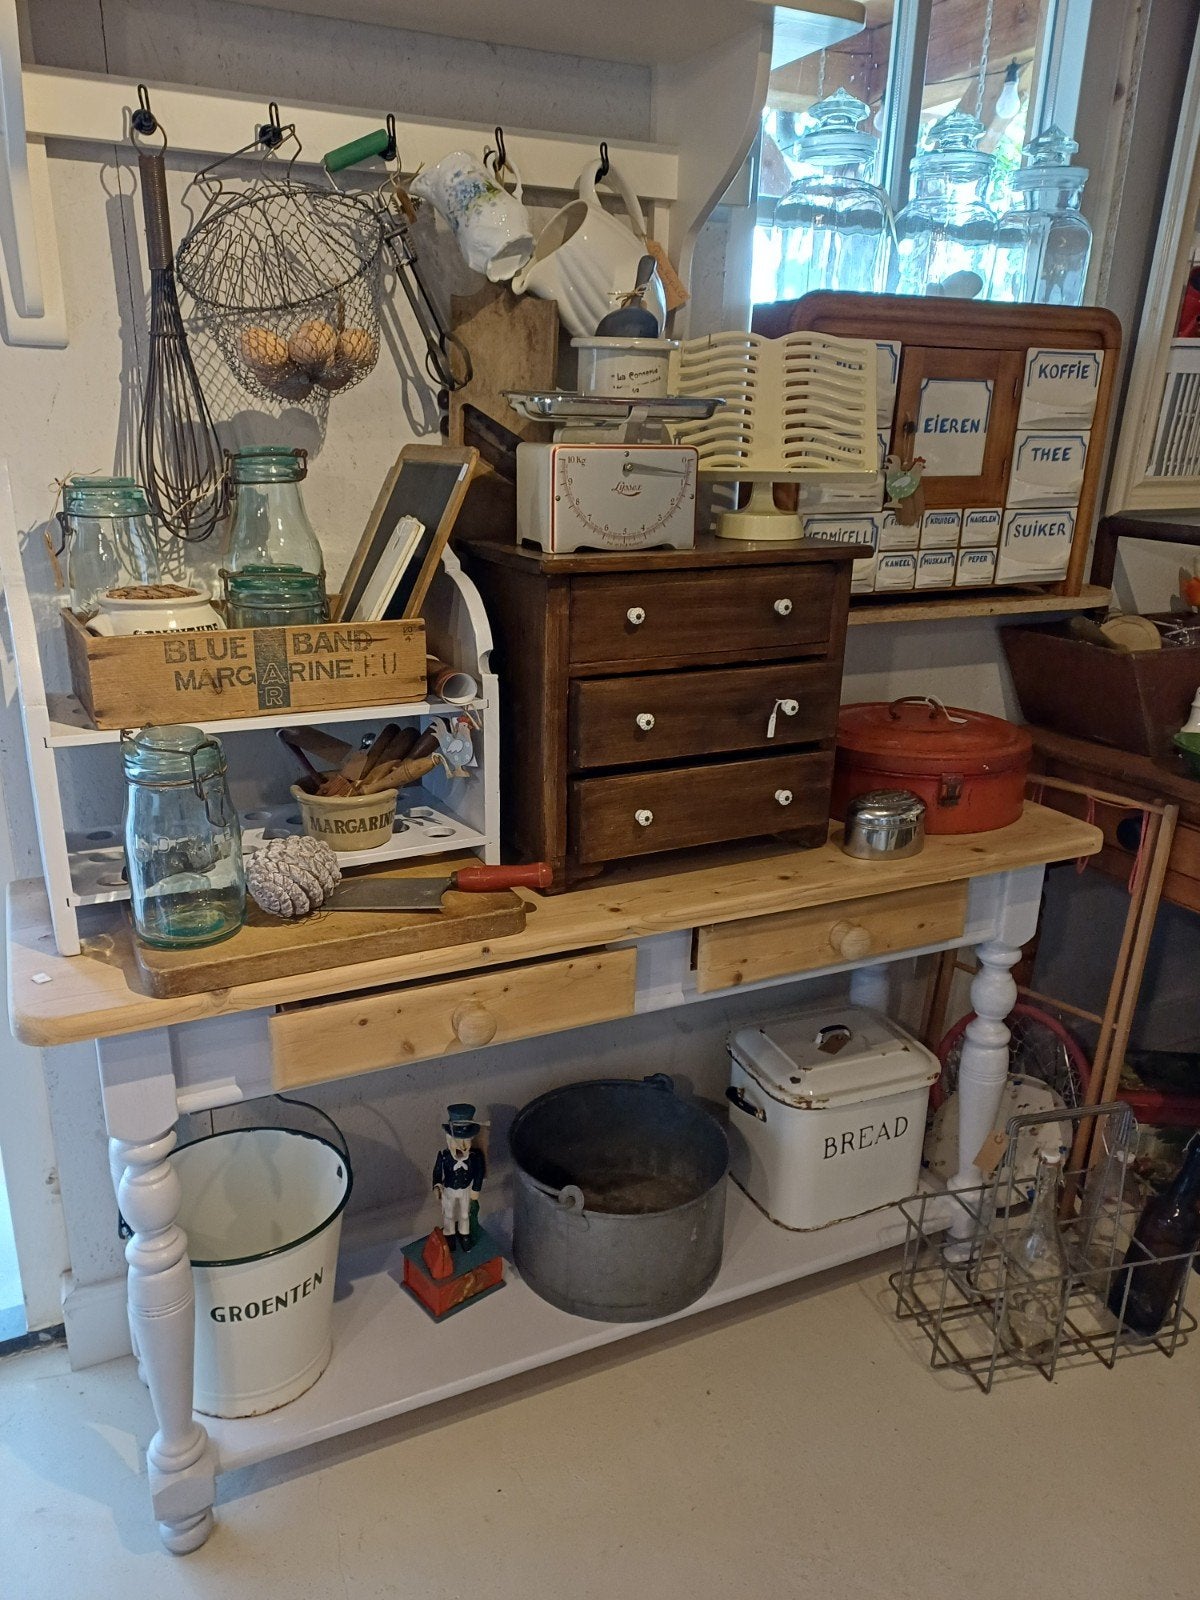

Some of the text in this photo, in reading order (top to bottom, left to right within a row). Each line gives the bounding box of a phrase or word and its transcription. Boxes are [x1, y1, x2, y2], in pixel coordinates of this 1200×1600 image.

[1031, 447, 1072, 462] THEE
[567, 477, 573, 485] 9
[970, 515, 997, 523] NAGELEN
[885, 559, 911, 567] KANEEL
[923, 556, 952, 566] MUSKAAT
[968, 555, 988, 563] PEPER
[163, 629, 373, 664] BLUE BAND
[823, 1116, 909, 1160] BREAD
[209, 1266, 324, 1323] GROENTEN
